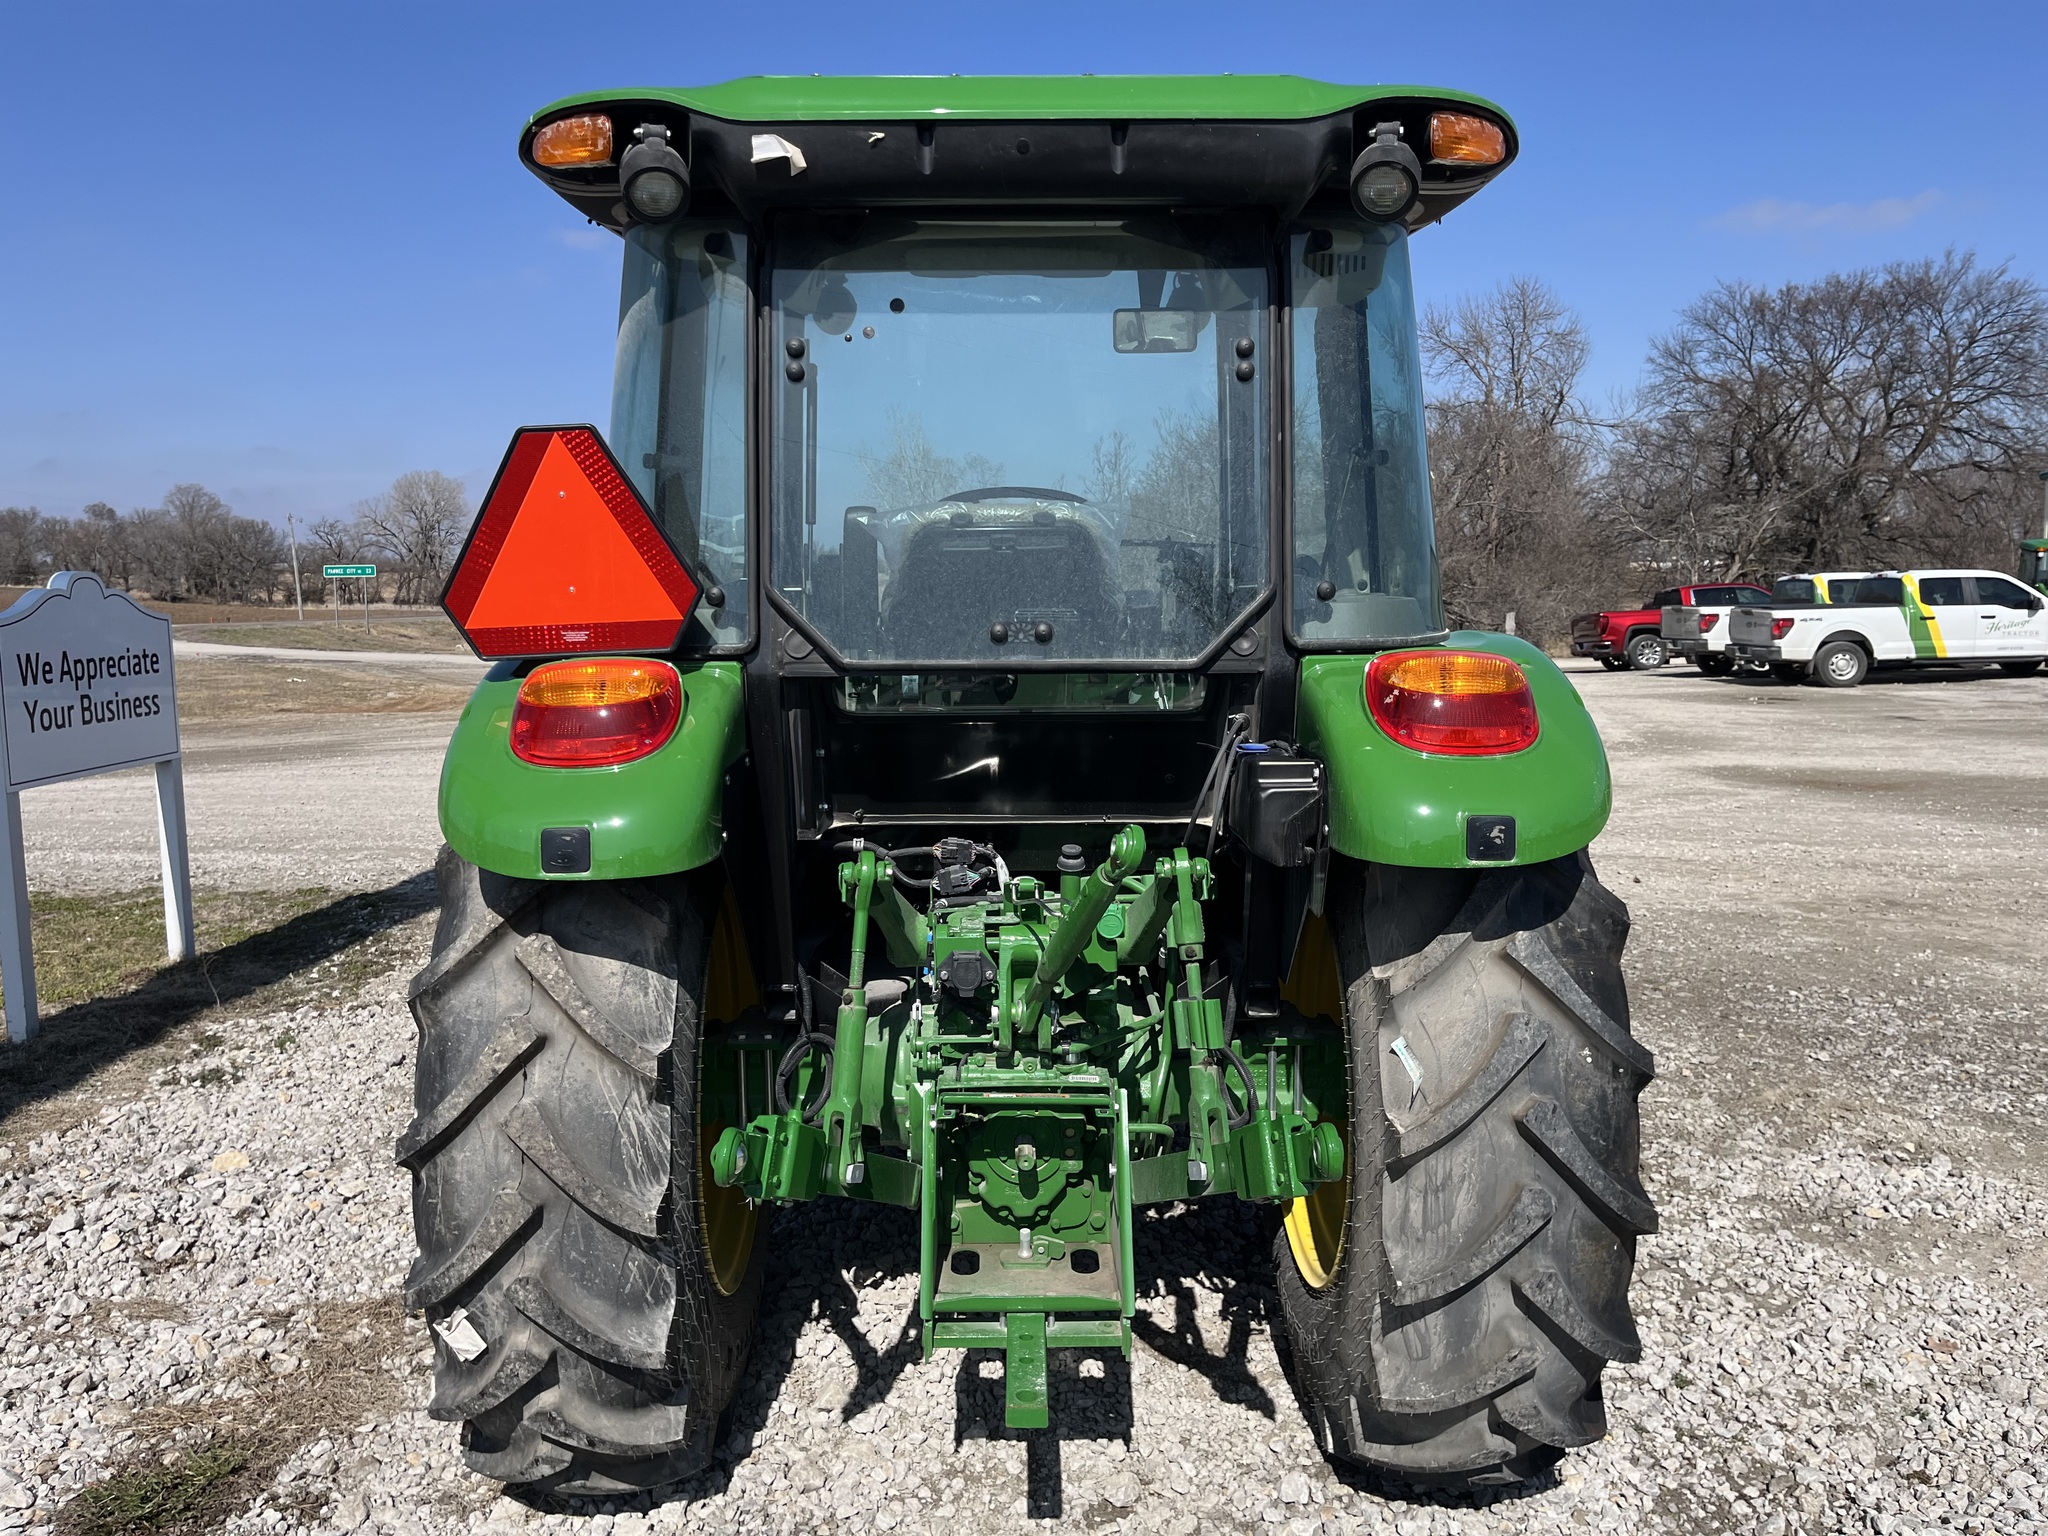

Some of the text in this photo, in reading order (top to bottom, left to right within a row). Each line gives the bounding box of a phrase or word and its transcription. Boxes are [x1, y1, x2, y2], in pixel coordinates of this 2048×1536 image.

[1984, 619, 2032, 635] Heritage
[16, 647, 160, 691] We Appreciate
[23, 692, 161, 733] Your Business
